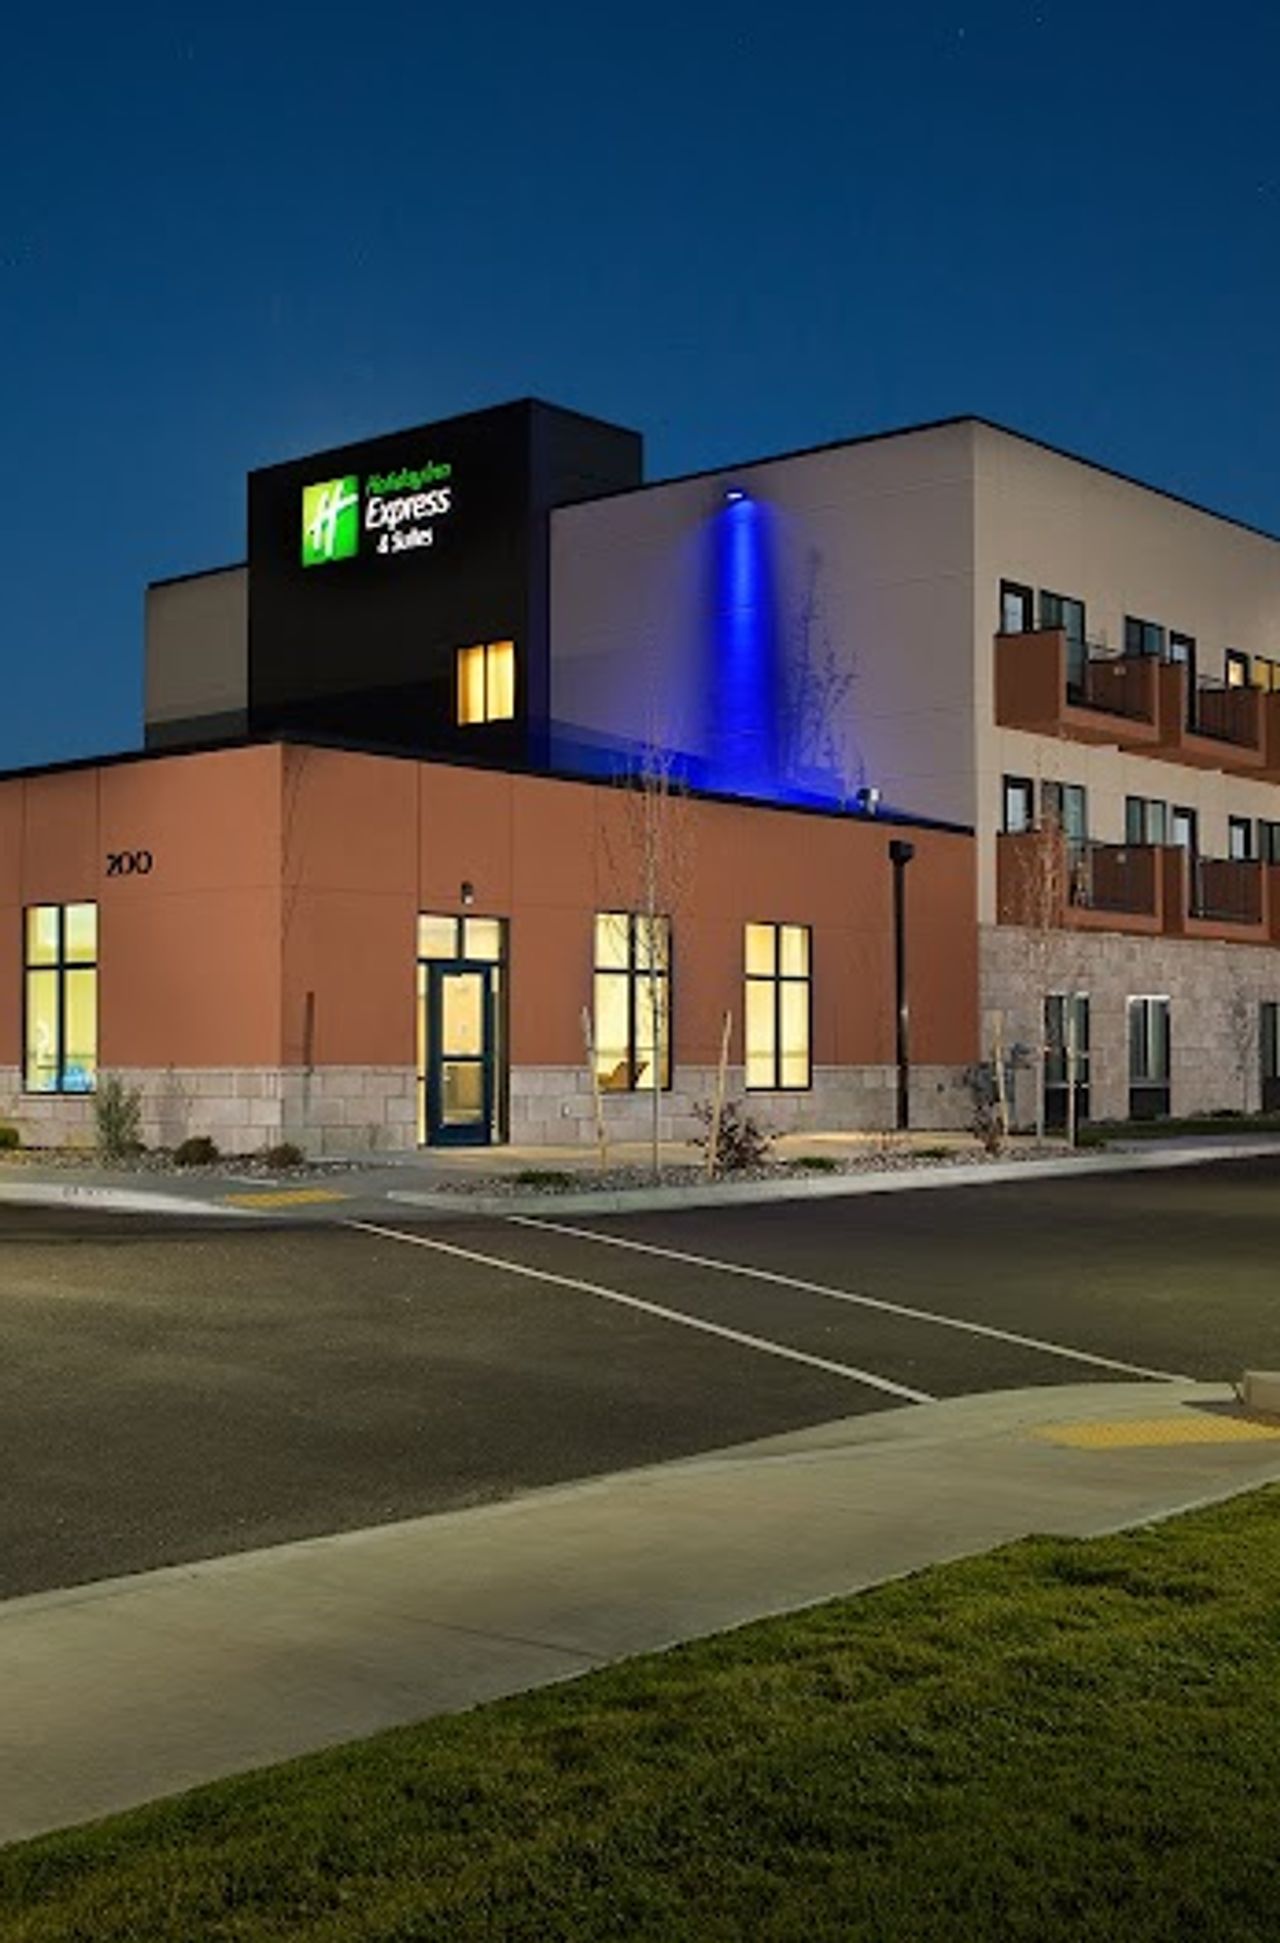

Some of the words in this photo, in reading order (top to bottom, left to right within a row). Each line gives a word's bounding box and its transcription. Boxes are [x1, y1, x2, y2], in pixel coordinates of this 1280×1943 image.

[365, 487, 452, 532] Express
[391, 527, 433, 553] Suites
[106, 851, 153, 877] 200
